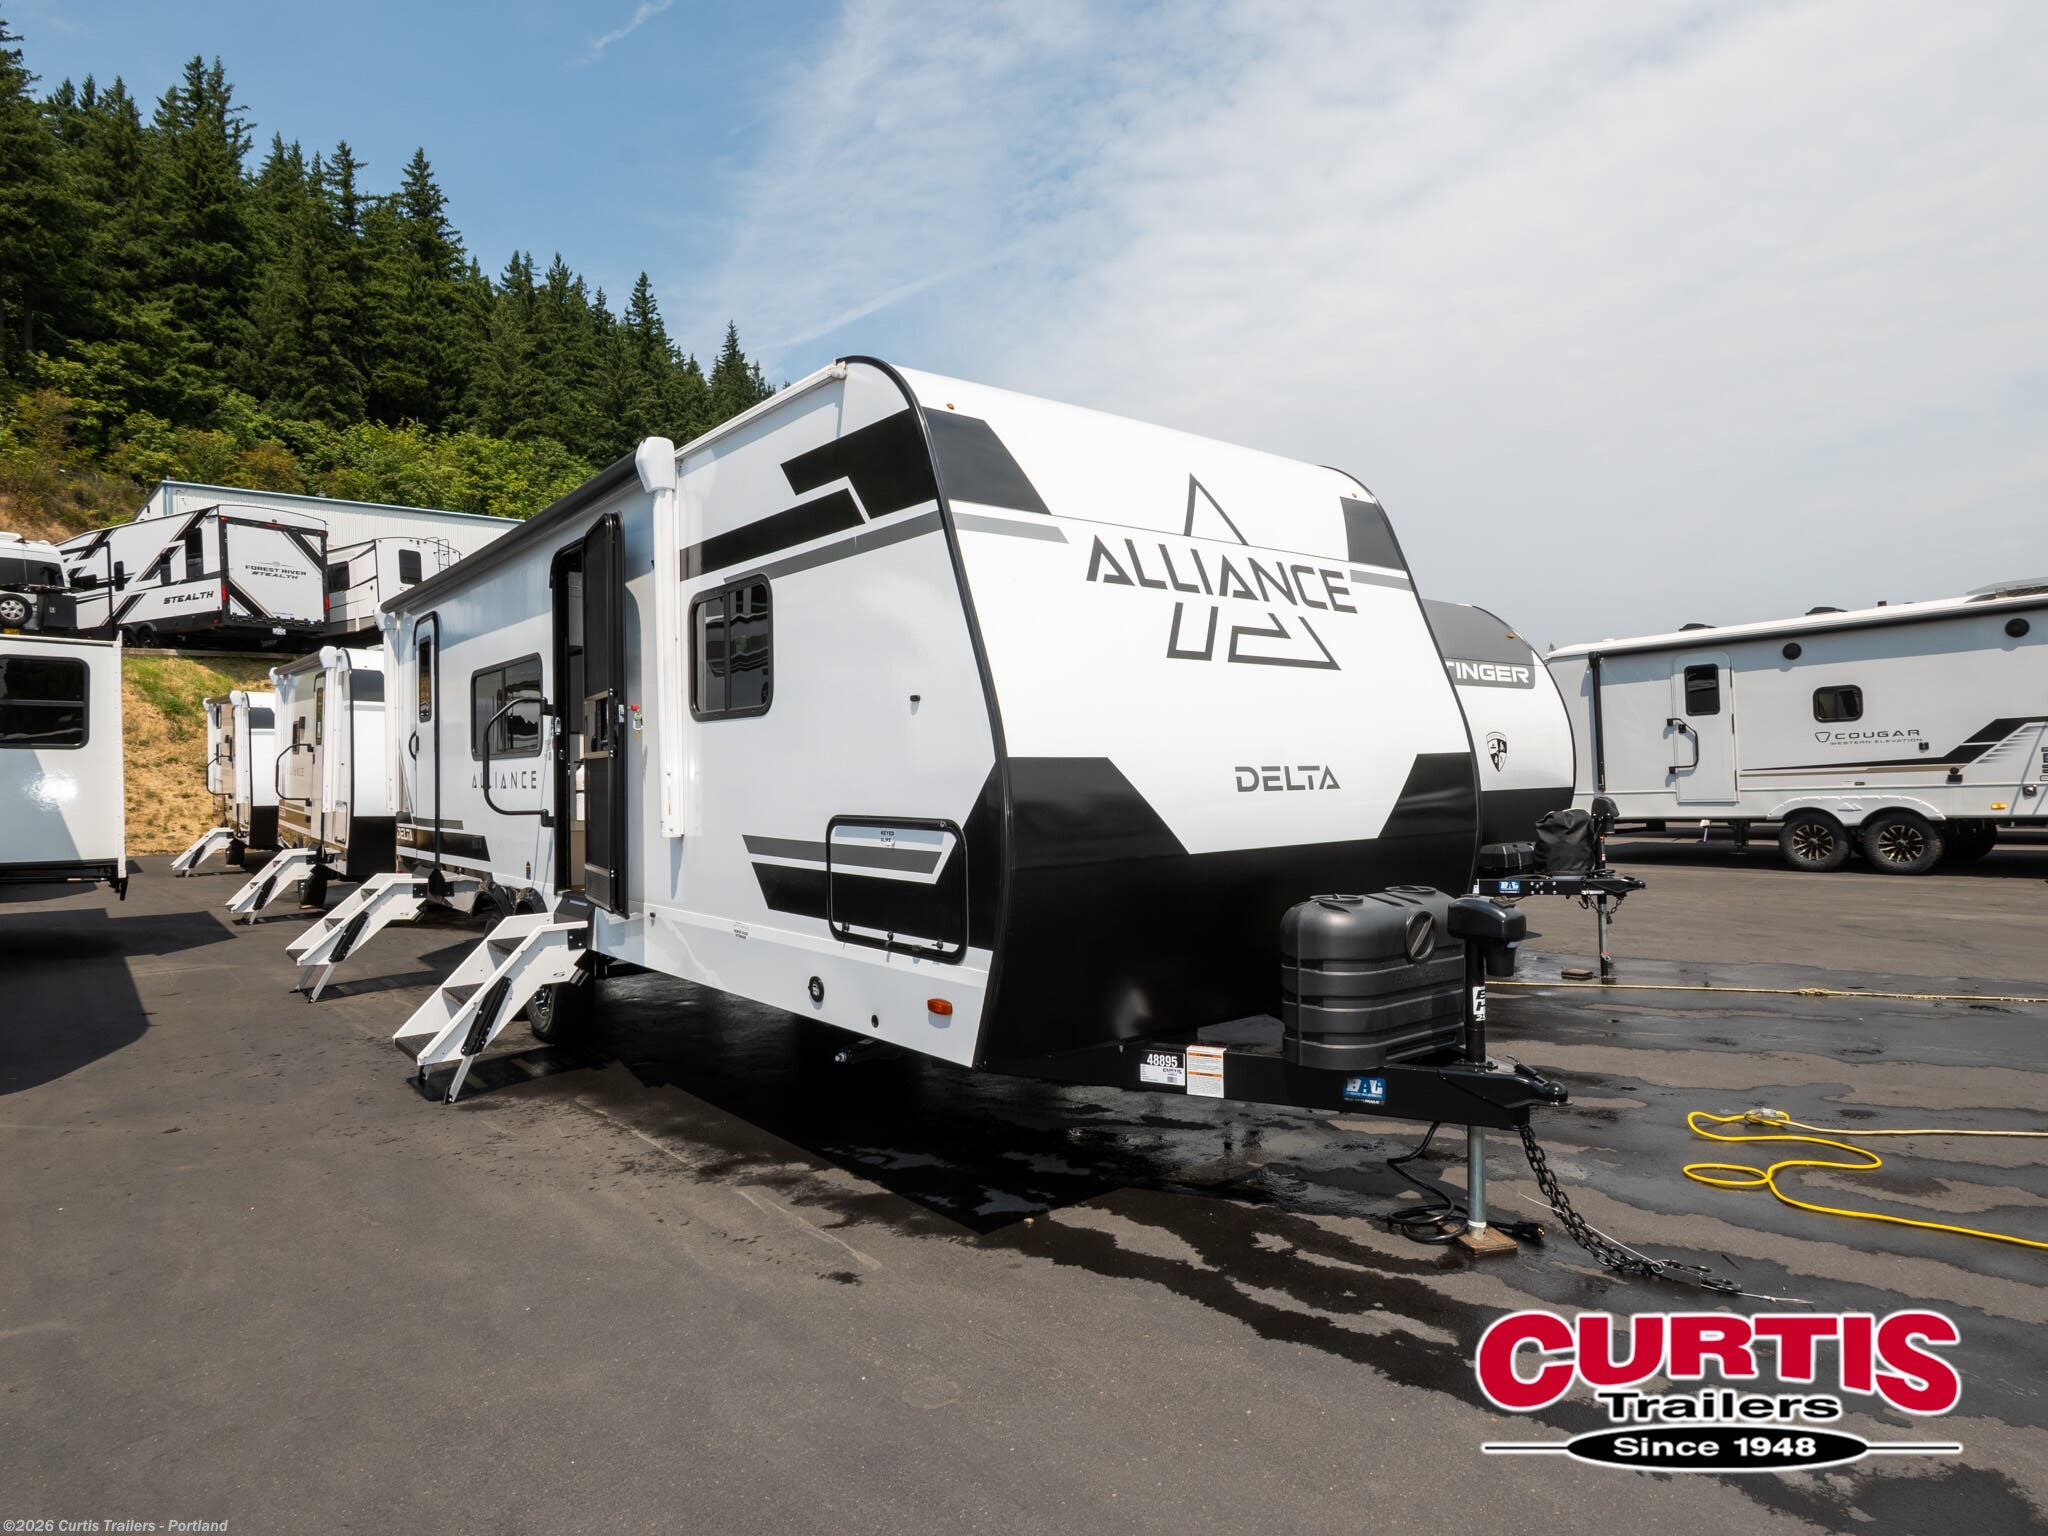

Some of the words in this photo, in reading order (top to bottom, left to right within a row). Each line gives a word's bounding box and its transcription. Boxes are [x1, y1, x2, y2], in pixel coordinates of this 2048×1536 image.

[245, 564, 279, 573] FOREST
[251, 570, 298, 580] STEALTH
[1086, 533, 1358, 614] ALLIANCE
[163, 590, 214, 605] STEALTH
[1445, 660, 1530, 683] INGER
[1835, 729, 1920, 740] COUGAR
[472, 770, 536, 789] ALIANCE
[1235, 765, 1341, 793] DELTA
[1147, 1053, 1178, 1068] 48895
